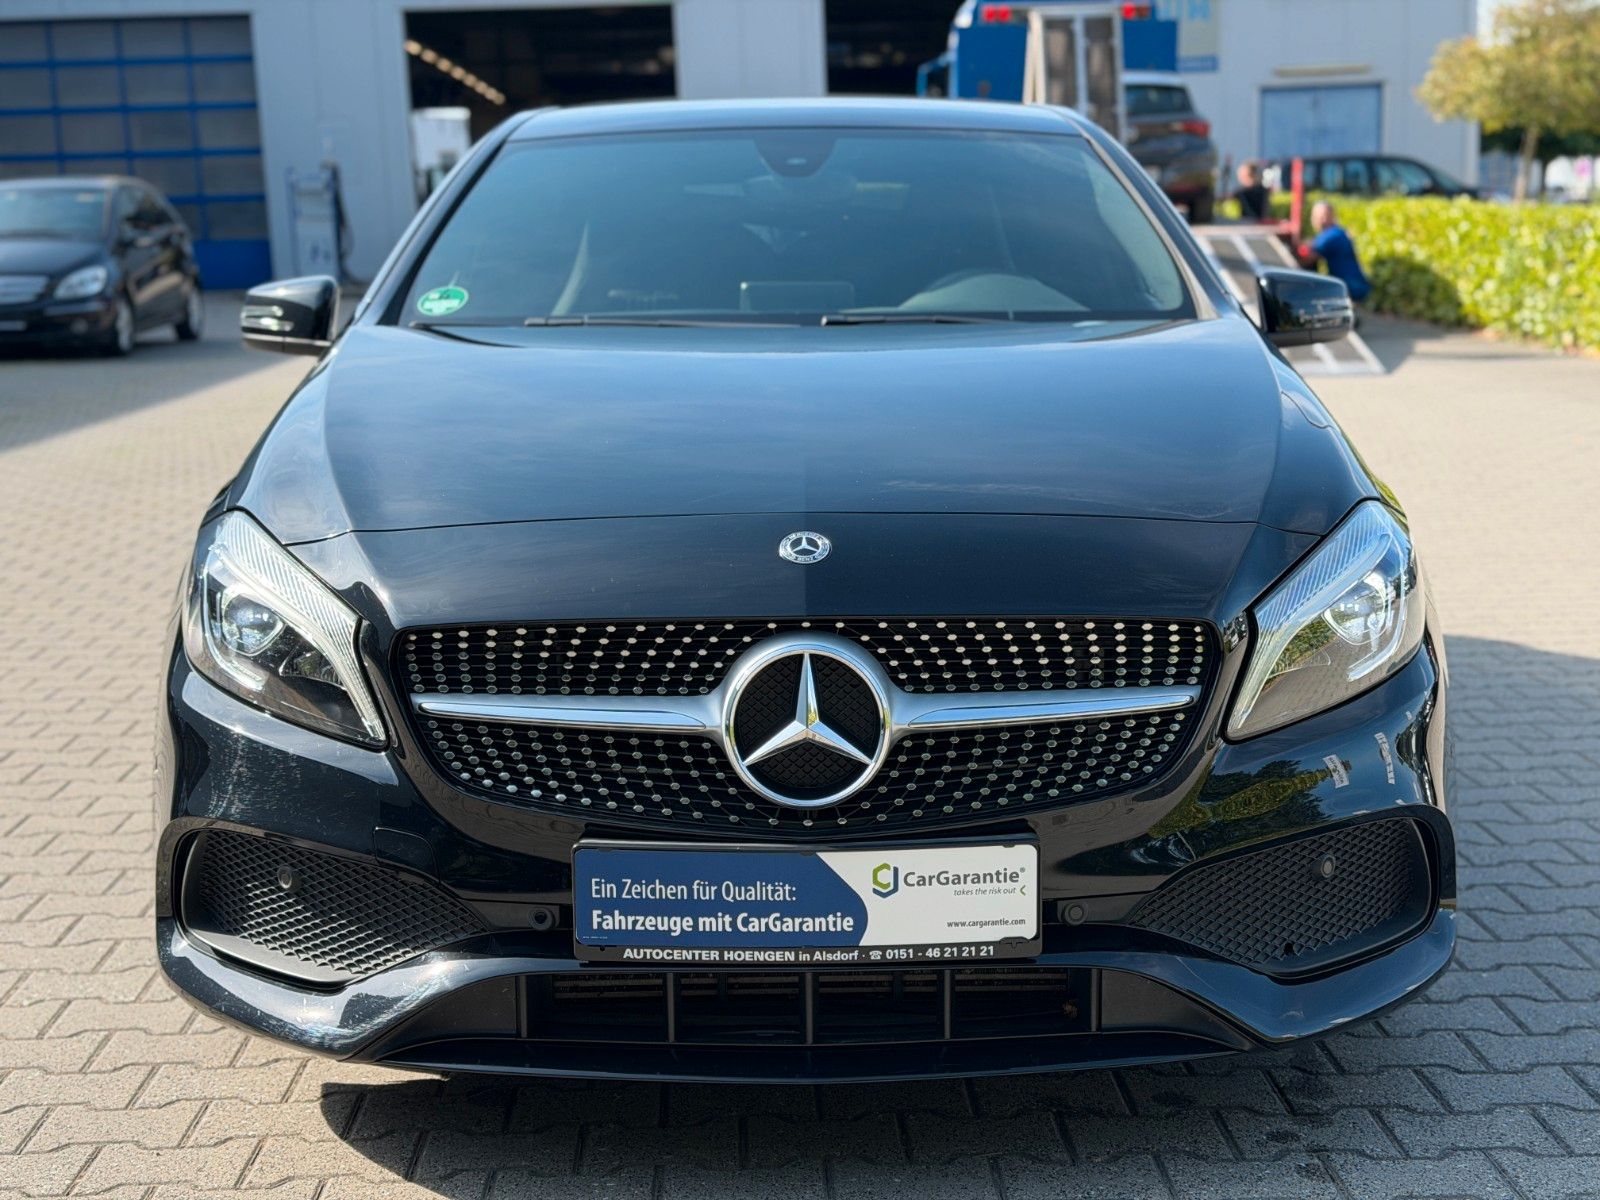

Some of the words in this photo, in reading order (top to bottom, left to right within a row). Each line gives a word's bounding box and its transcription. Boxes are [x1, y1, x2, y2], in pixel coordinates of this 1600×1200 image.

[591, 878, 617, 898] Ein
[621, 879, 688, 900] Zeichen
[692, 880, 718, 900] für
[721, 880, 797, 903] Qualität:
[953, 888, 973, 896] takes
[974, 888, 987, 896] the
[988, 887, 1002, 895] risk
[592, 909, 694, 936] Fahrzeuge
[698, 912, 733, 932] mit
[736, 911, 855, 932] CarGarantie
[946, 918, 1026, 928] www.cargarantie.com
[623, 948, 720, 961] AUTOCENTER
[724, 950, 795, 962] HOENGEN
[798, 951, 811, 962] in
[812, 950, 859, 962] Alsdorf
[886, 948, 914, 960] 0151
[925, 947, 941, 958] 46
[943, 946, 958, 958] 21
[961, 946, 976, 957] 21
[979, 945, 995, 956] 21
